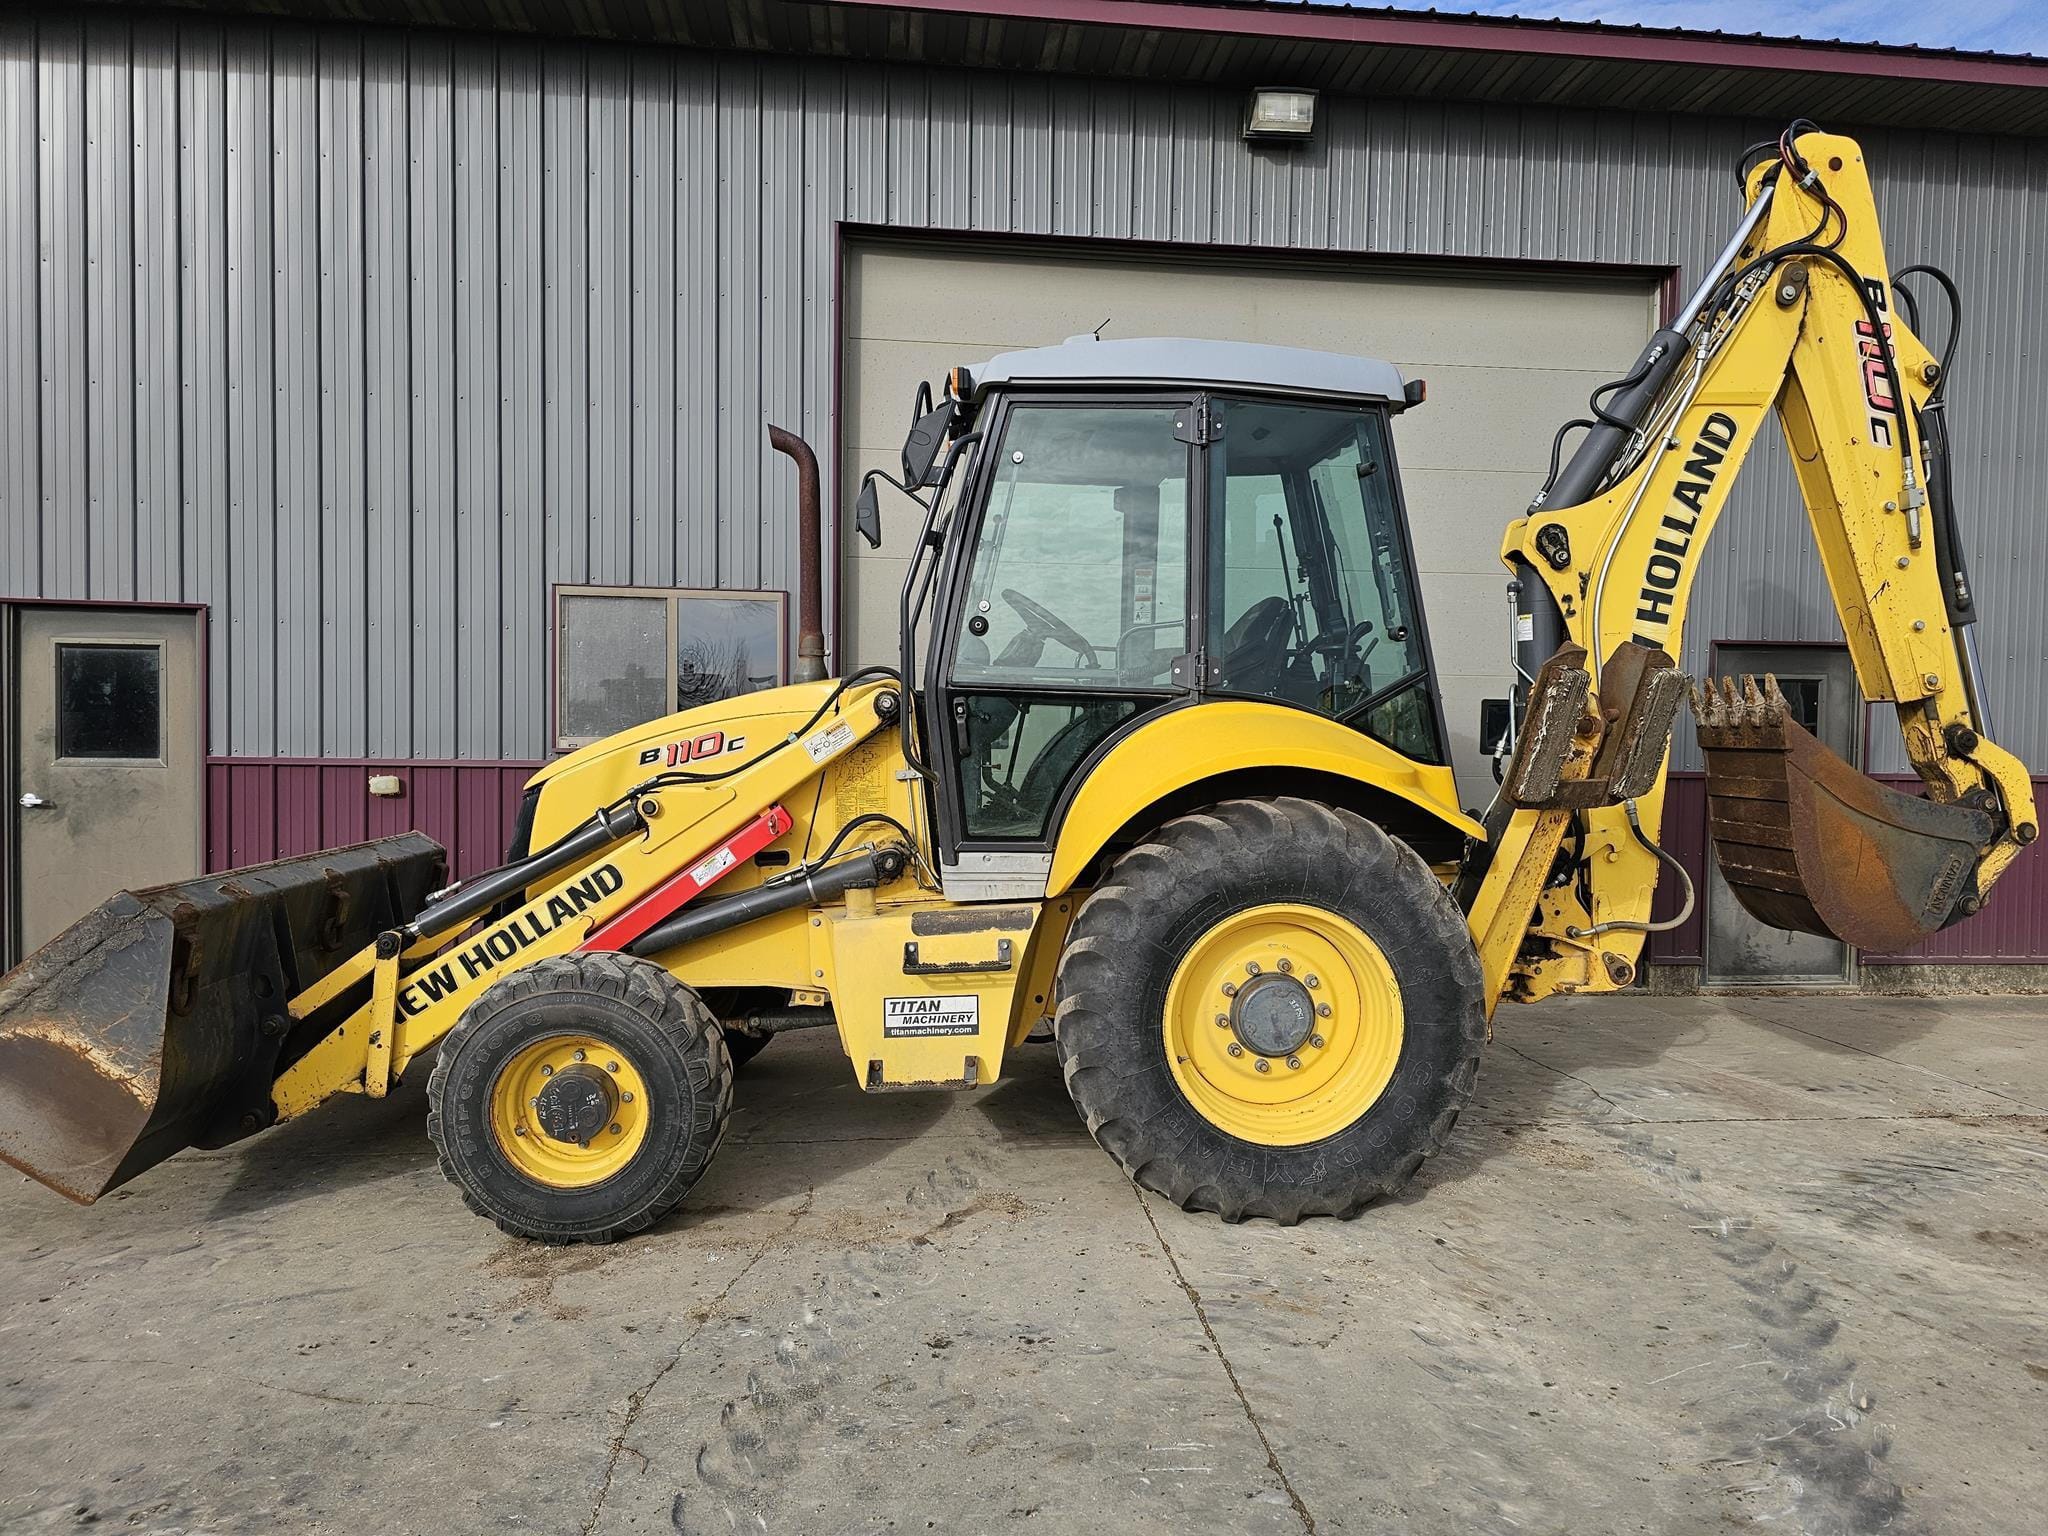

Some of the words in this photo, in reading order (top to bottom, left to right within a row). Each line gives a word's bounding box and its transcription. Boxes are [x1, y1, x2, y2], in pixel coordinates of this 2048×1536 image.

[1636, 412, 1737, 625] HOLLAND
[457, 864, 623, 980] HOLLAND
[889, 1000, 941, 1013] TITAN
[902, 1014, 974, 1025] MACHINERY
[890, 1026, 973, 1036] titanmachinery.com
